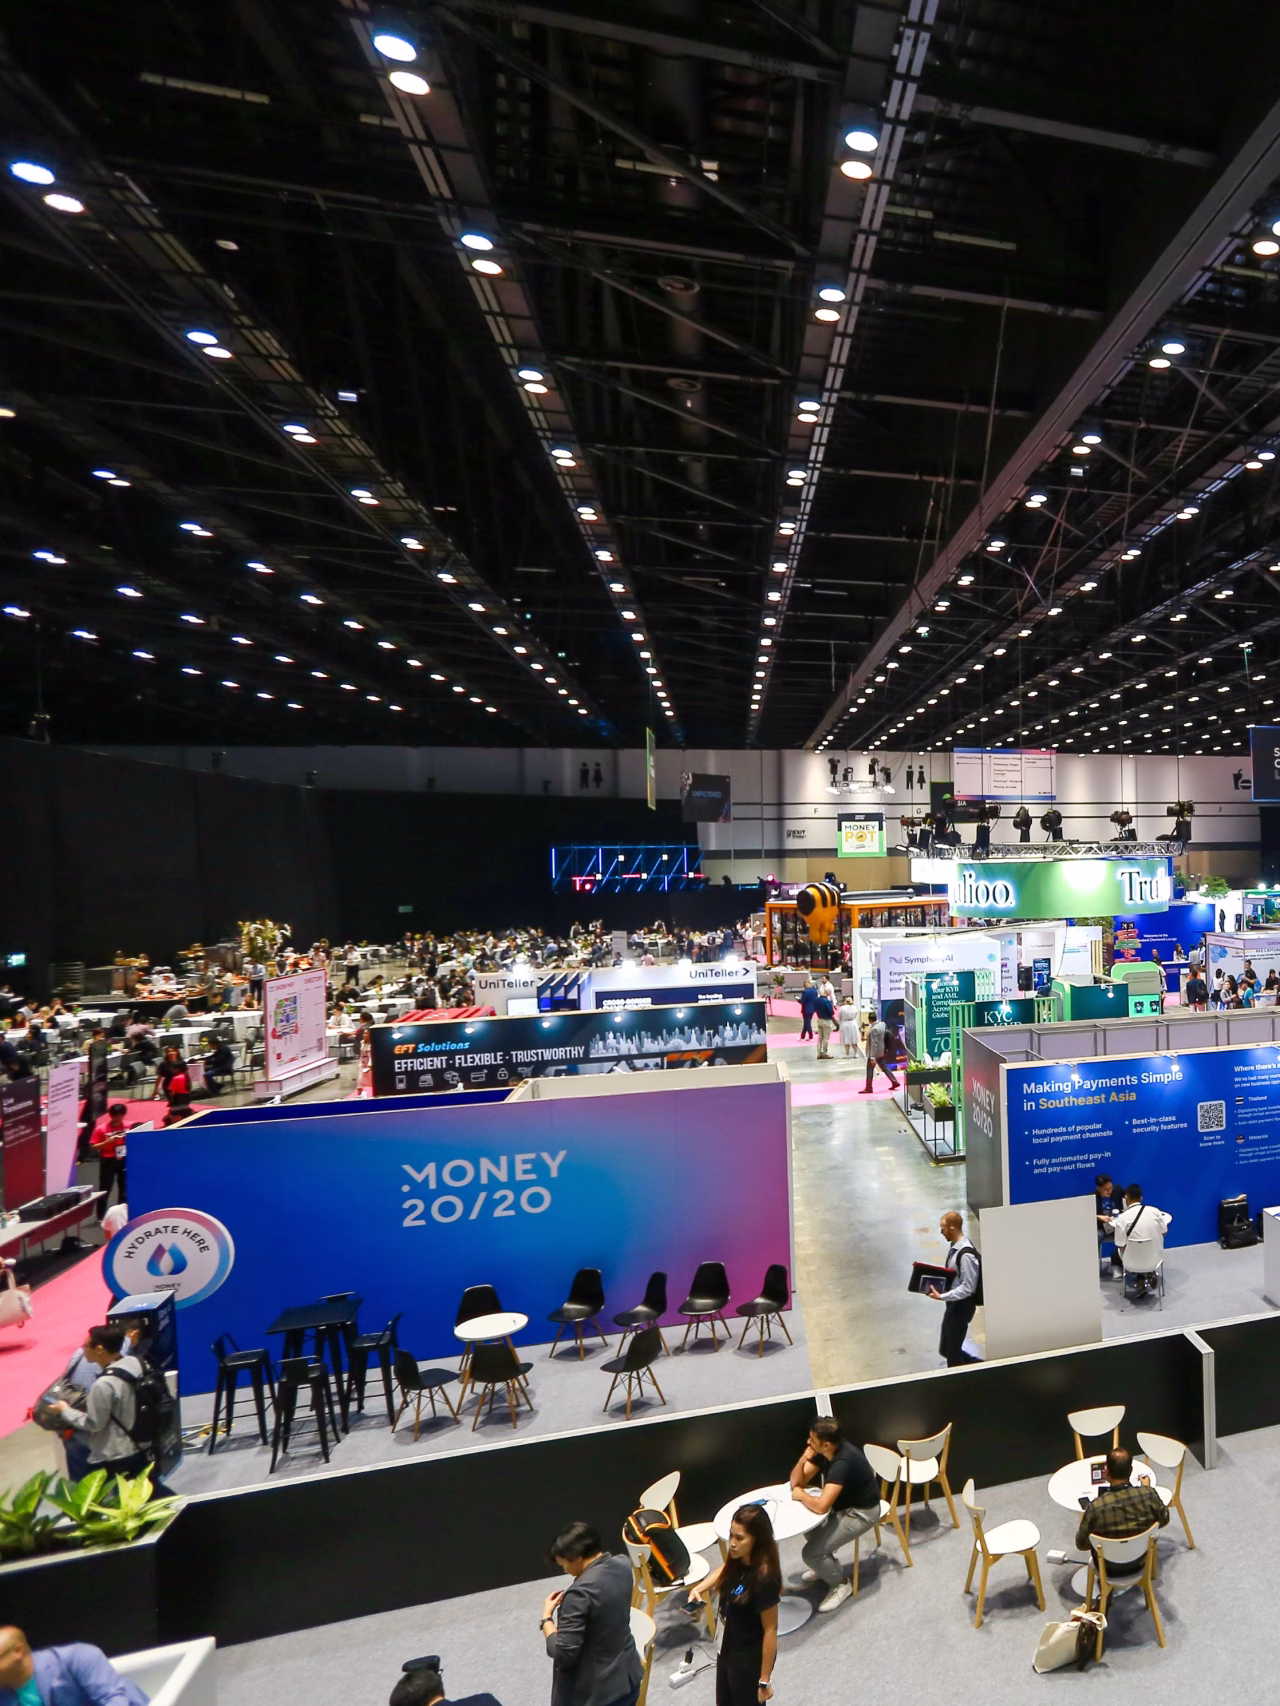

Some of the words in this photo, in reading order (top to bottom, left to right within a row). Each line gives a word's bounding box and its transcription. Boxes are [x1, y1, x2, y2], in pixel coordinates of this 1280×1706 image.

[692, 790, 722, 798] UNFILTERED
[845, 831, 876, 843] POT
[904, 956, 954, 965] SymphonyAI
[689, 968, 739, 979] UniTeller
[479, 978, 535, 990] UniTeller
[984, 1011, 1013, 1024] KYC
[394, 1043, 415, 1054] EFT
[417, 1041, 470, 1053] Solutions
[394, 1056, 447, 1072] EFFICIENT
[455, 1052, 503, 1068] FLEXIBLE
[511, 1046, 585, 1063] TRUSTWORTHY
[1234, 1064, 1255, 1073] Where
[1255, 1062, 1276, 1071] there's
[1023, 1079, 1072, 1095] Making
[1074, 1074, 1138, 1091] Payments
[1141, 1070, 1183, 1085] Simple
[1251, 1079, 1271, 1087] business
[971, 1077, 995, 1114] MONEY
[1023, 1099, 1036, 1111] in
[1039, 1093, 1106, 1110] Southeast
[1109, 1090, 1137, 1103] Asia
[972, 1106, 993, 1139] 20/20
[1132, 1115, 1176, 1125] Best-in-class
[1032, 1125, 1067, 1136] Hundreds
[1067, 1124, 1075, 1132] of
[1076, 1122, 1103, 1133] popular
[1132, 1125, 1159, 1135] security
[1160, 1121, 1188, 1131] features
[1032, 1136, 1049, 1145] local
[1050, 1133, 1081, 1144] payment
[1082, 1129, 1113, 1139] channels
[1033, 1158, 1049, 1167] Fully
[1051, 1154, 1088, 1164] automated
[1089, 1150, 1112, 1161] pay-in
[402, 1150, 568, 1193] MONEY
[1033, 1166, 1046, 1174] and
[1048, 1163, 1075, 1174] pay-out
[1077, 1160, 1095, 1170] flows
[402, 1186, 551, 1228] 20/20
[123, 1225, 180, 1259] HYDRATE
[181, 1228, 210, 1253] HERE
[153, 1282, 182, 1290] MONEY
